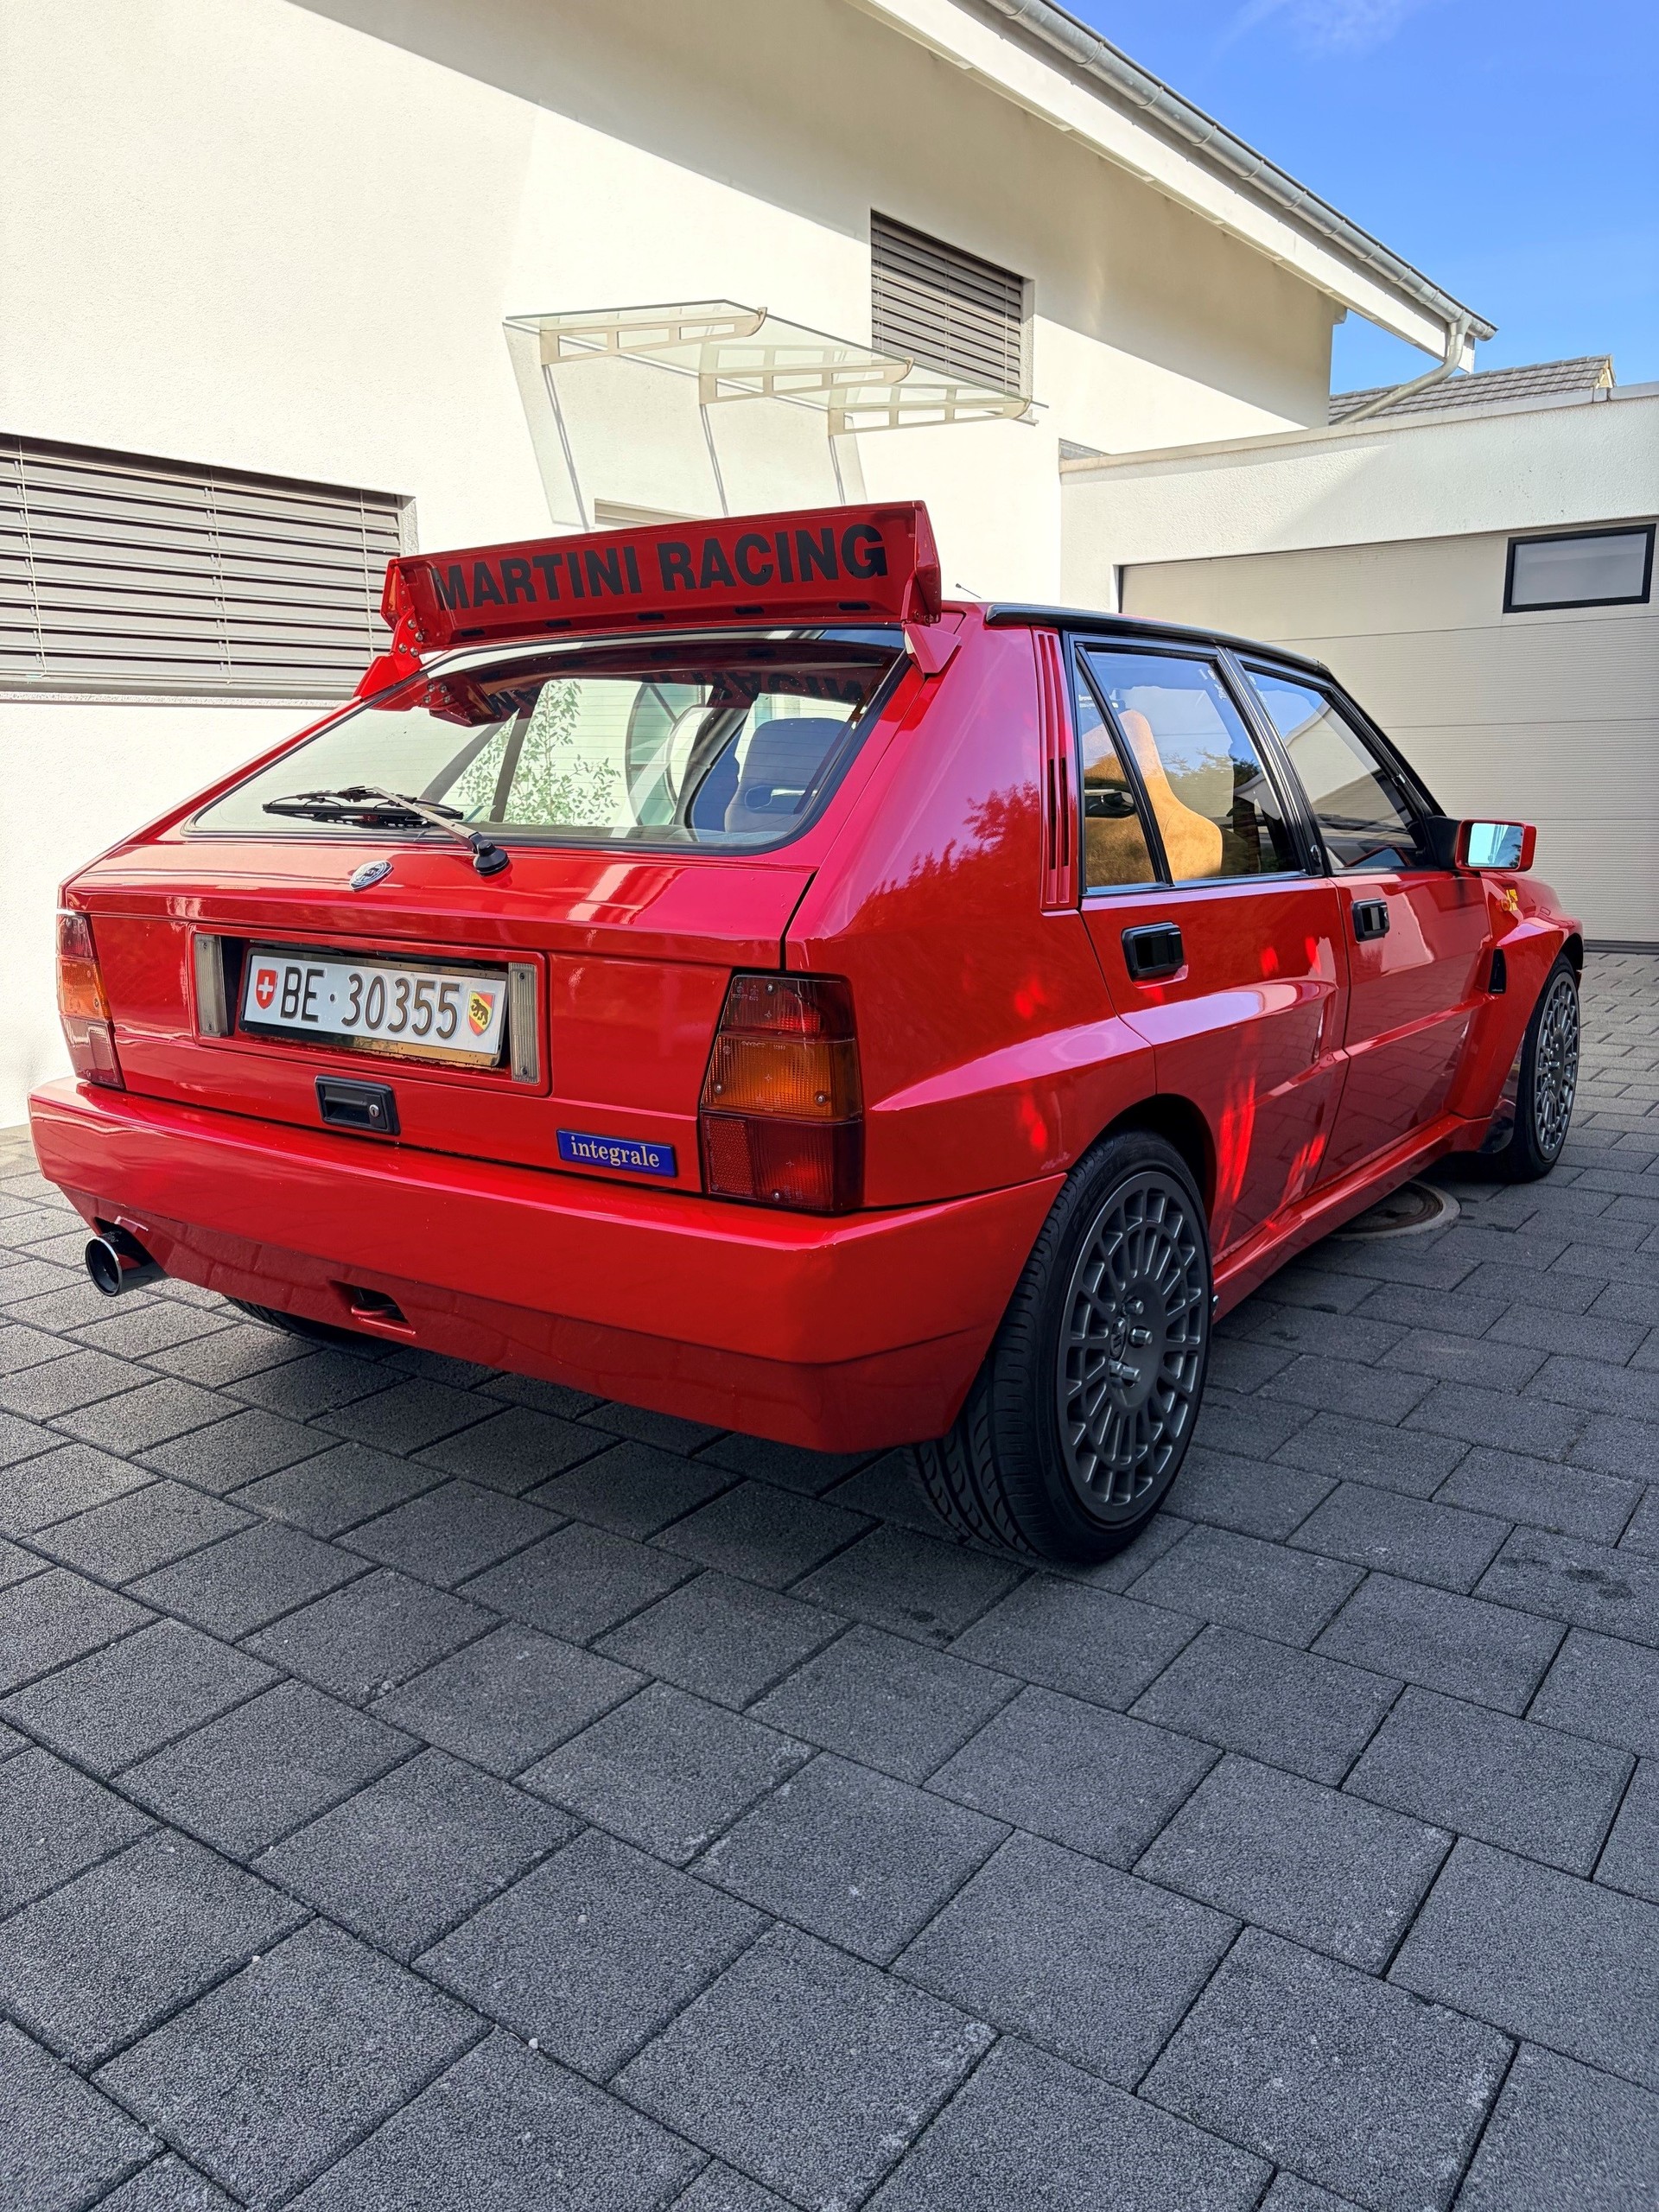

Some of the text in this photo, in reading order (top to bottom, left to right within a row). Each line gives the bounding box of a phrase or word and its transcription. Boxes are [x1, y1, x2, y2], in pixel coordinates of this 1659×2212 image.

[436, 524, 888, 610] MARTINI RACING
[280, 966, 461, 1039] BE 30355
[570, 1135, 660, 1167] integrale
